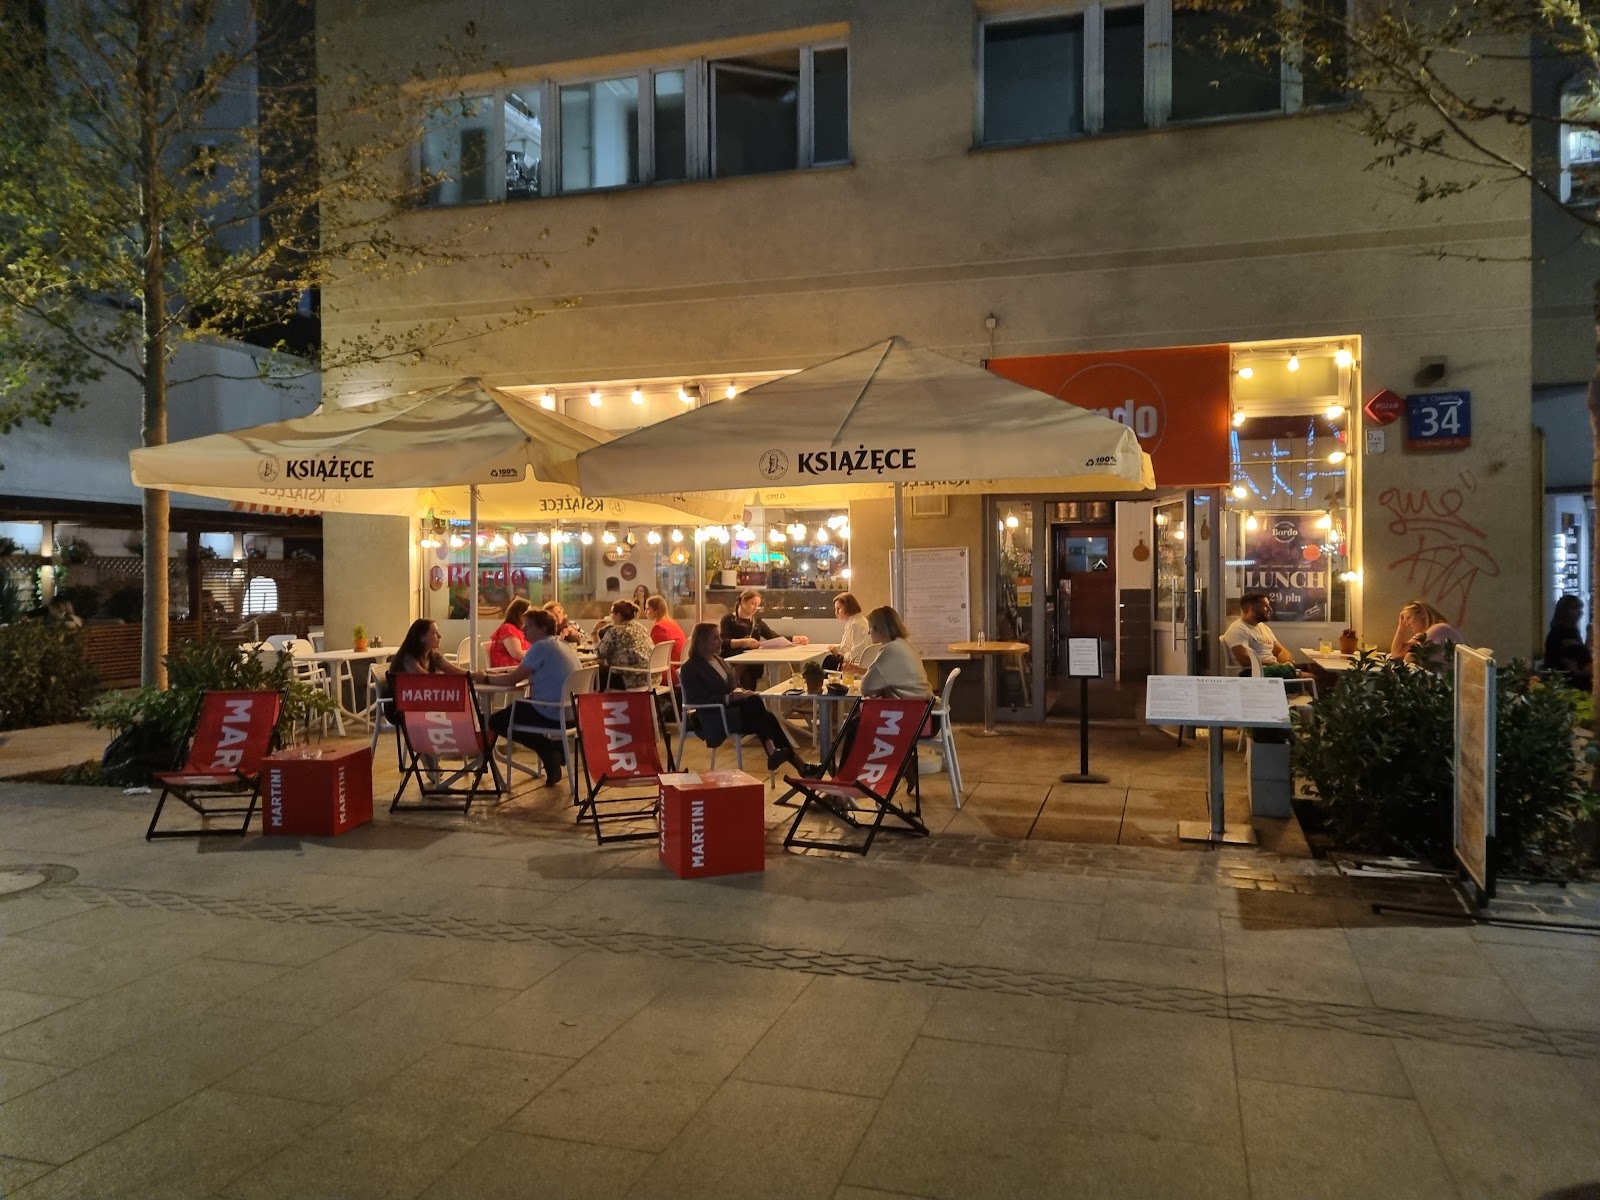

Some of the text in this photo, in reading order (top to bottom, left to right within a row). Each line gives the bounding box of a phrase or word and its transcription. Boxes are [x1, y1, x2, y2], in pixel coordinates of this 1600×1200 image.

[1421, 405, 1461, 436] 34
[286, 455, 375, 483] KSIĄŻĘCE
[798, 445, 916, 475] KSIĄŻĘCE
[1272, 528, 1298, 536] Bordo
[1246, 571, 1325, 588] LUNCH
[1269, 593, 1301, 604] 29 pln
[402, 689, 460, 702] MARTINI
[210, 699, 254, 772] MAR
[601, 701, 641, 774] MAR
[856, 710, 904, 789] MAR
[270, 768, 283, 827] MARTINI
[338, 766, 347, 825] MARTINI
[691, 800, 704, 868] MARTINI
